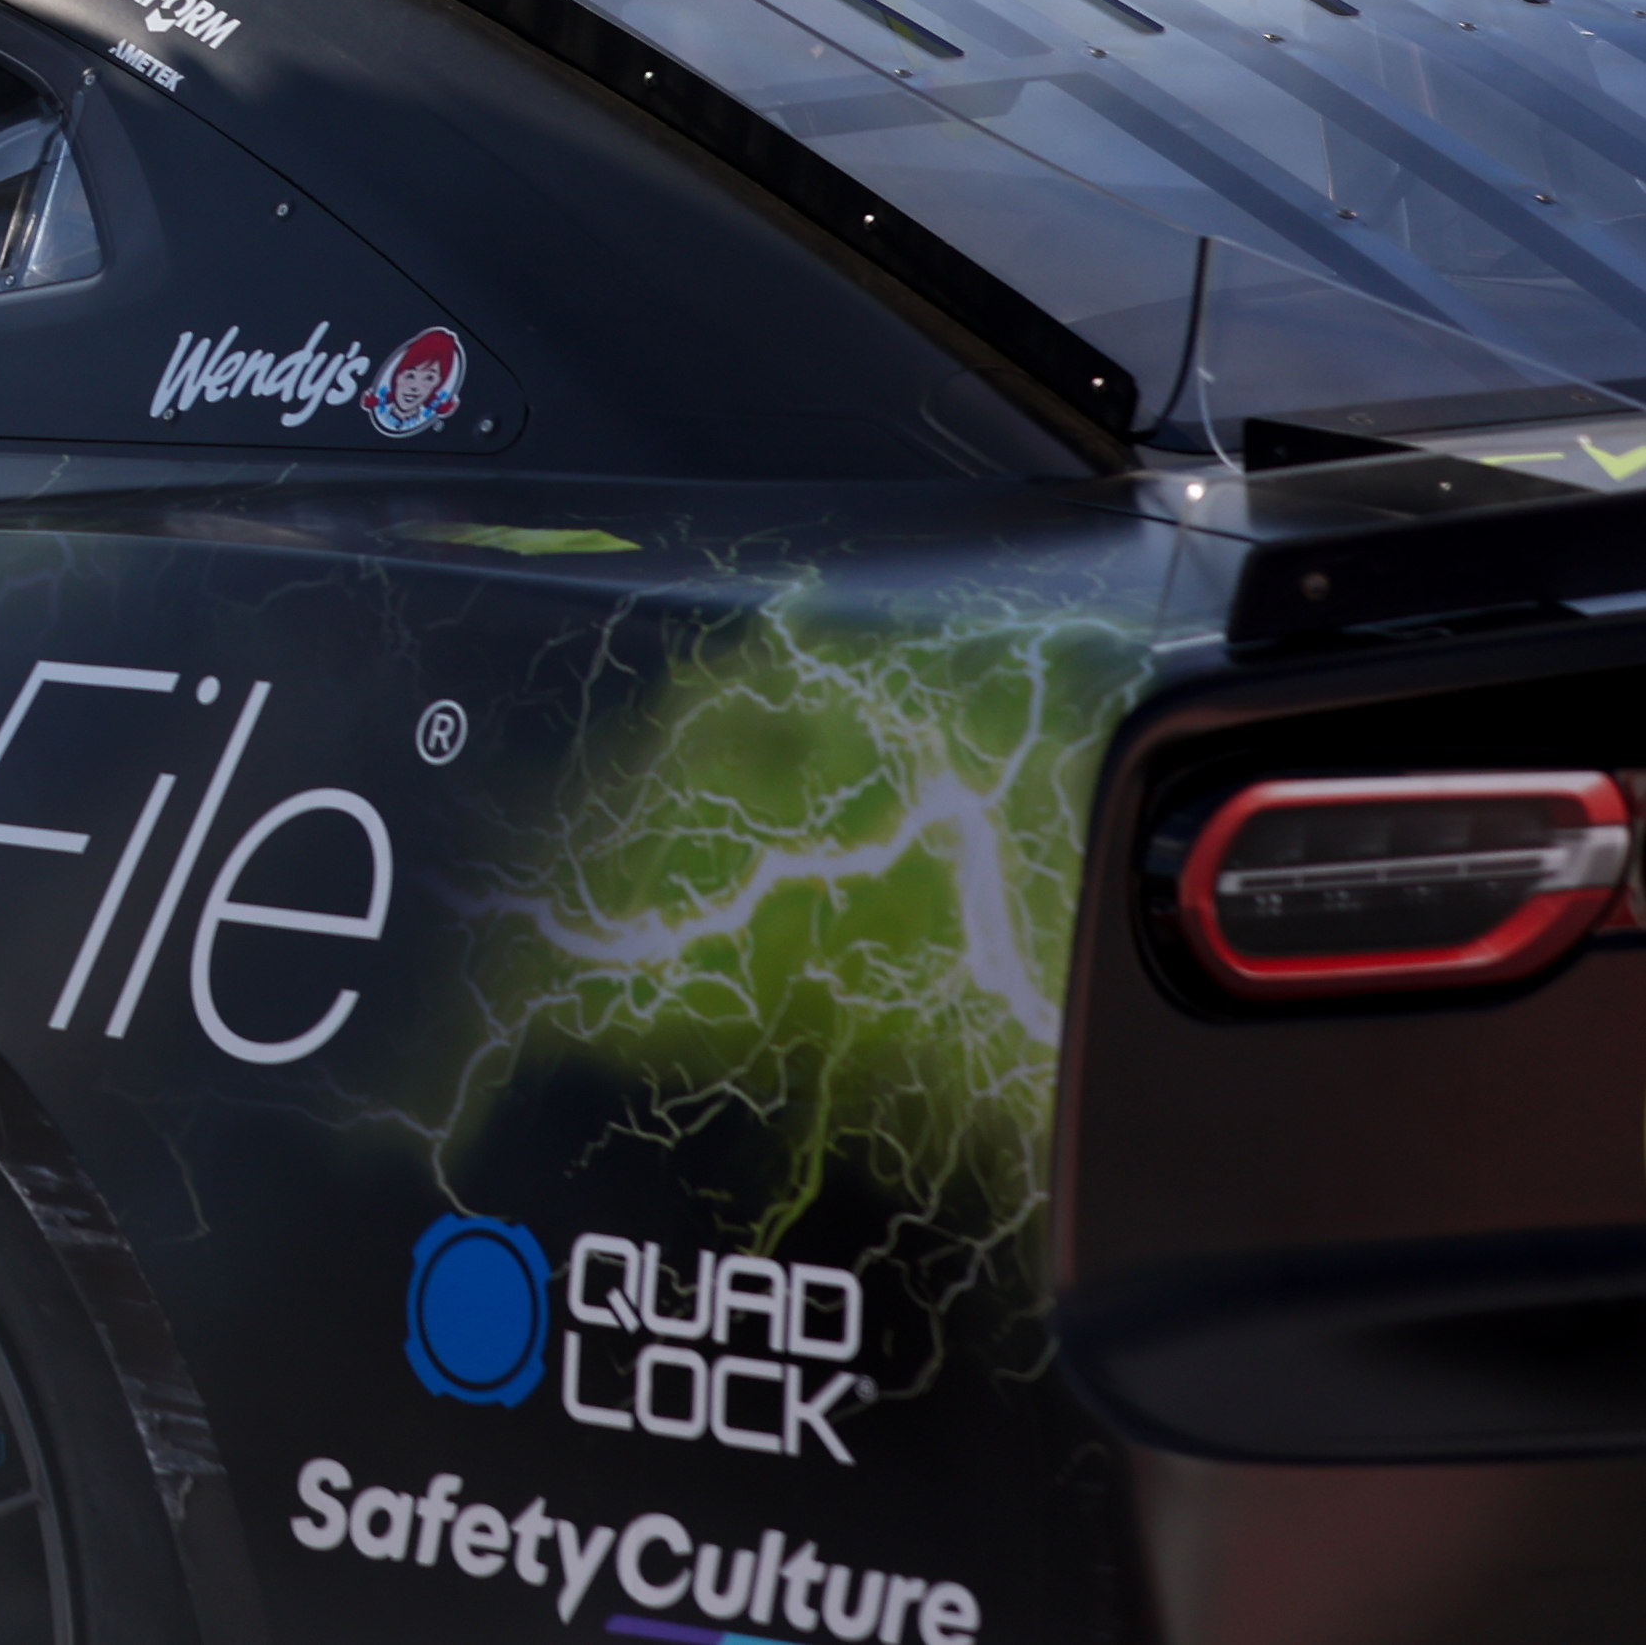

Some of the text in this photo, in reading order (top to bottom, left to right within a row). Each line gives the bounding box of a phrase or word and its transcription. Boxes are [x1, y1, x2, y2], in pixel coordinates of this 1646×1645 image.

[108, 38, 186, 93] AMETEK
[149, 320, 370, 428] Wendy's
[567, 1232, 863, 1361] QUAD
[562, 1330, 857, 1467] LOCK
[290, 1455, 982, 1645] SafetyCulture
